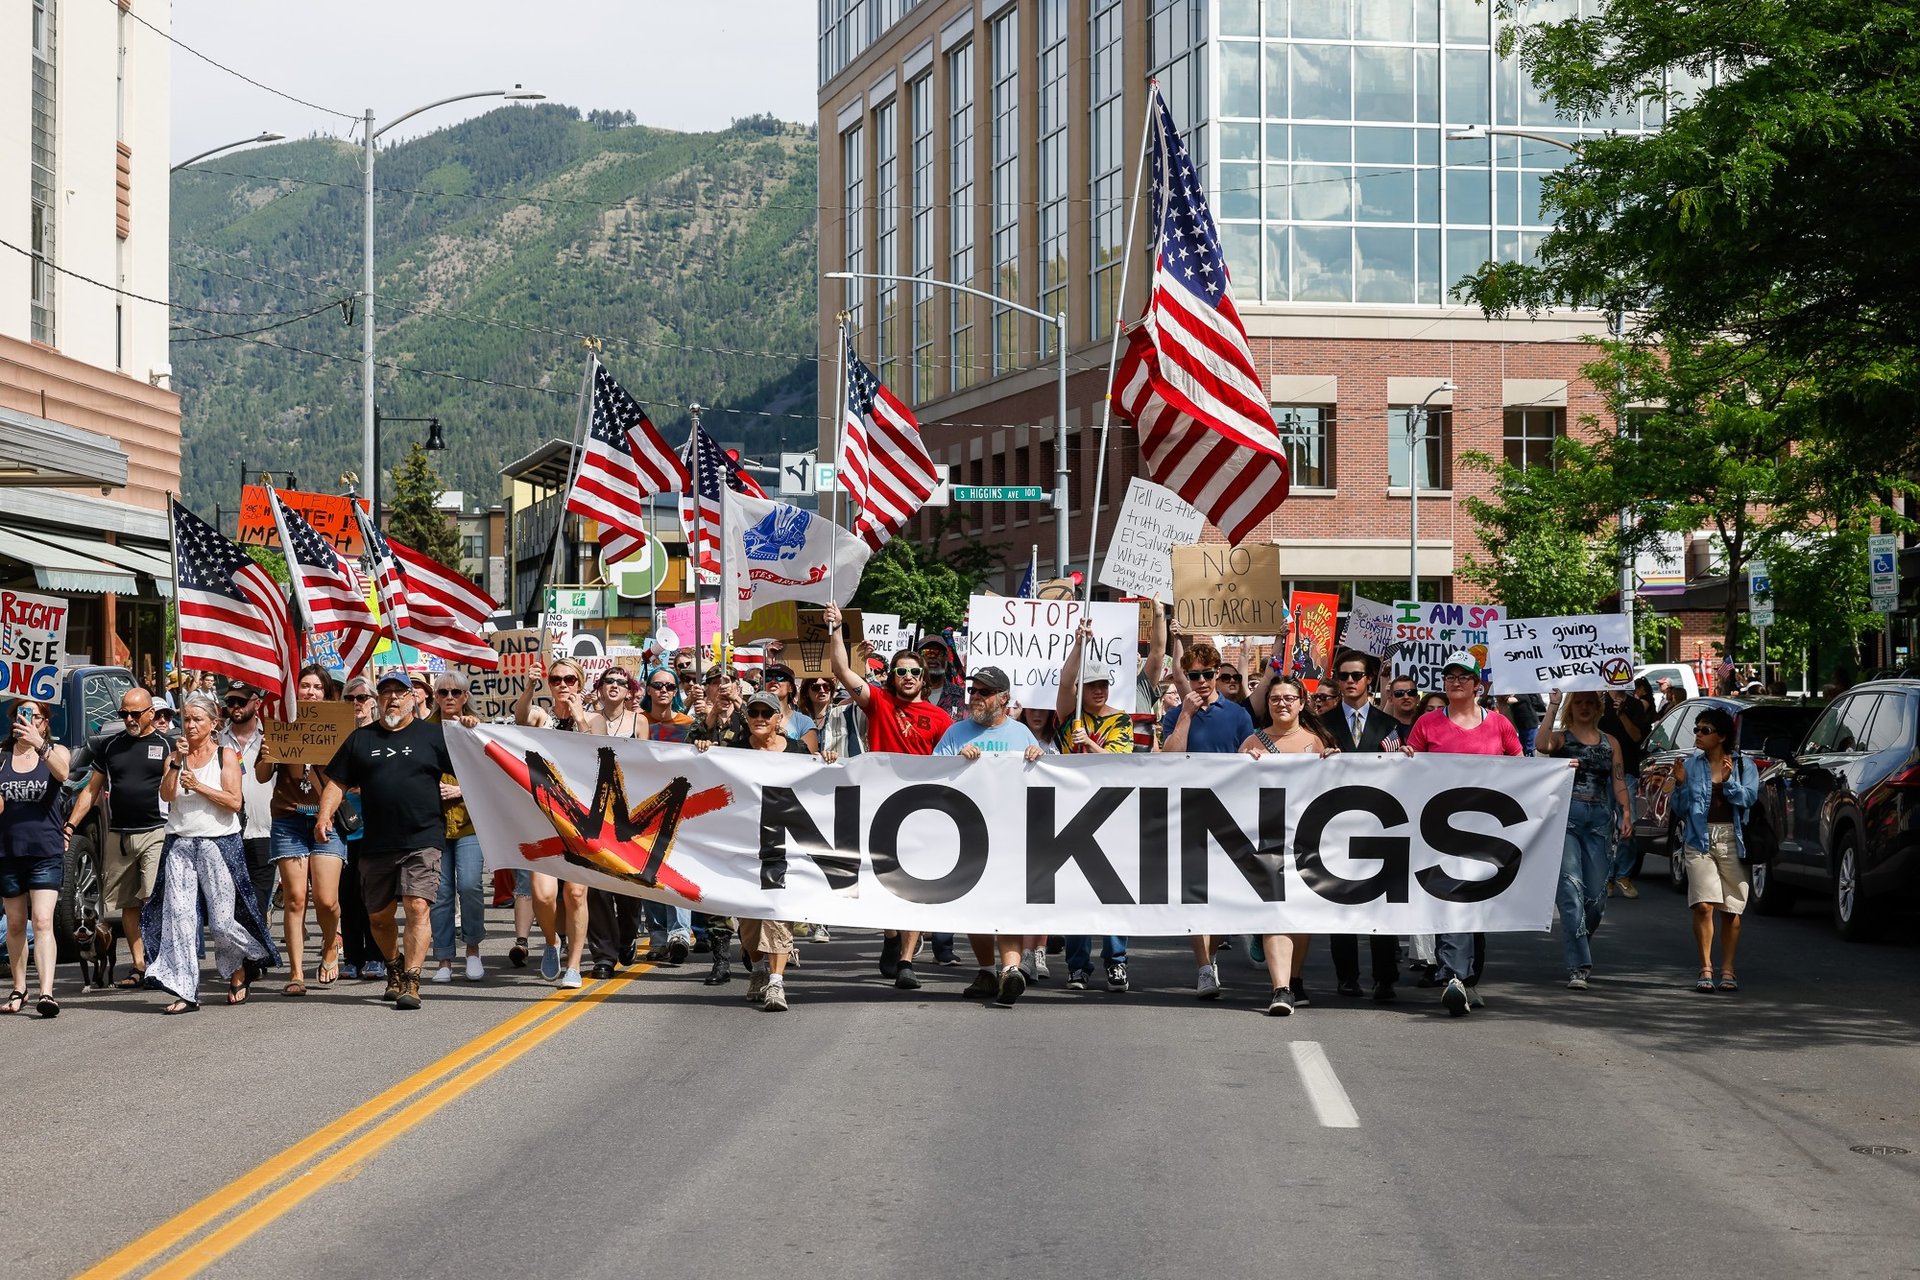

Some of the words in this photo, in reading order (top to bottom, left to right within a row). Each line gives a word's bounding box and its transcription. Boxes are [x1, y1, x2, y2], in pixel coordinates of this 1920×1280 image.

[960, 490, 966, 499] S
[970, 488, 1002, 499] HIGGINS
[1007, 490, 1019, 499] AVE
[1024, 488, 1036, 497] 100
[1133, 485, 1153, 507] Tell
[1155, 497, 1173, 513] us
[1175, 500, 1197, 520] the
[1127, 509, 1160, 534] truth
[1162, 524, 1194, 544] about
[1117, 545, 1148, 567] What
[1150, 557, 1163, 573] is
[1203, 547, 1251, 578] NO
[1112, 562, 1136, 583] being
[1138, 570, 1163, 586] done
[1116, 576, 1154, 593] them?
[1215, 582, 1237, 593] TO
[1, 592, 67, 631] RIGHT
[560, 608, 586, 616] Holiday
[1002, 600, 1080, 629] STOP
[1177, 597, 1277, 629] OLIGARCHY
[1317, 602, 1333, 621] BIG
[1396, 603, 1421, 623] I
[1429, 604, 1464, 626] AM
[868, 624, 890, 635] ARE
[1306, 611, 1331, 642] BEAUTIFUL
[1396, 624, 1436, 641] SICK
[1439, 629, 1457, 641] OF
[1461, 630, 1489, 644] THI
[1499, 622, 1537, 641] It's
[1552, 622, 1598, 642] giving
[969, 630, 1122, 666] KIDNAPPNG
[1302, 619, 1328, 658] RESISTANCE
[16, 637, 60, 665] SEE
[1503, 645, 1544, 662] small
[1535, 660, 1604, 681] ENERGY
[270, 733, 289, 742] THE
[273, 722, 307, 732] DIDNT
[309, 723, 337, 732] COME
[279, 746, 305, 758] WAY
[759, 783, 989, 904] NO
[1025, 785, 1529, 905] KINGS
